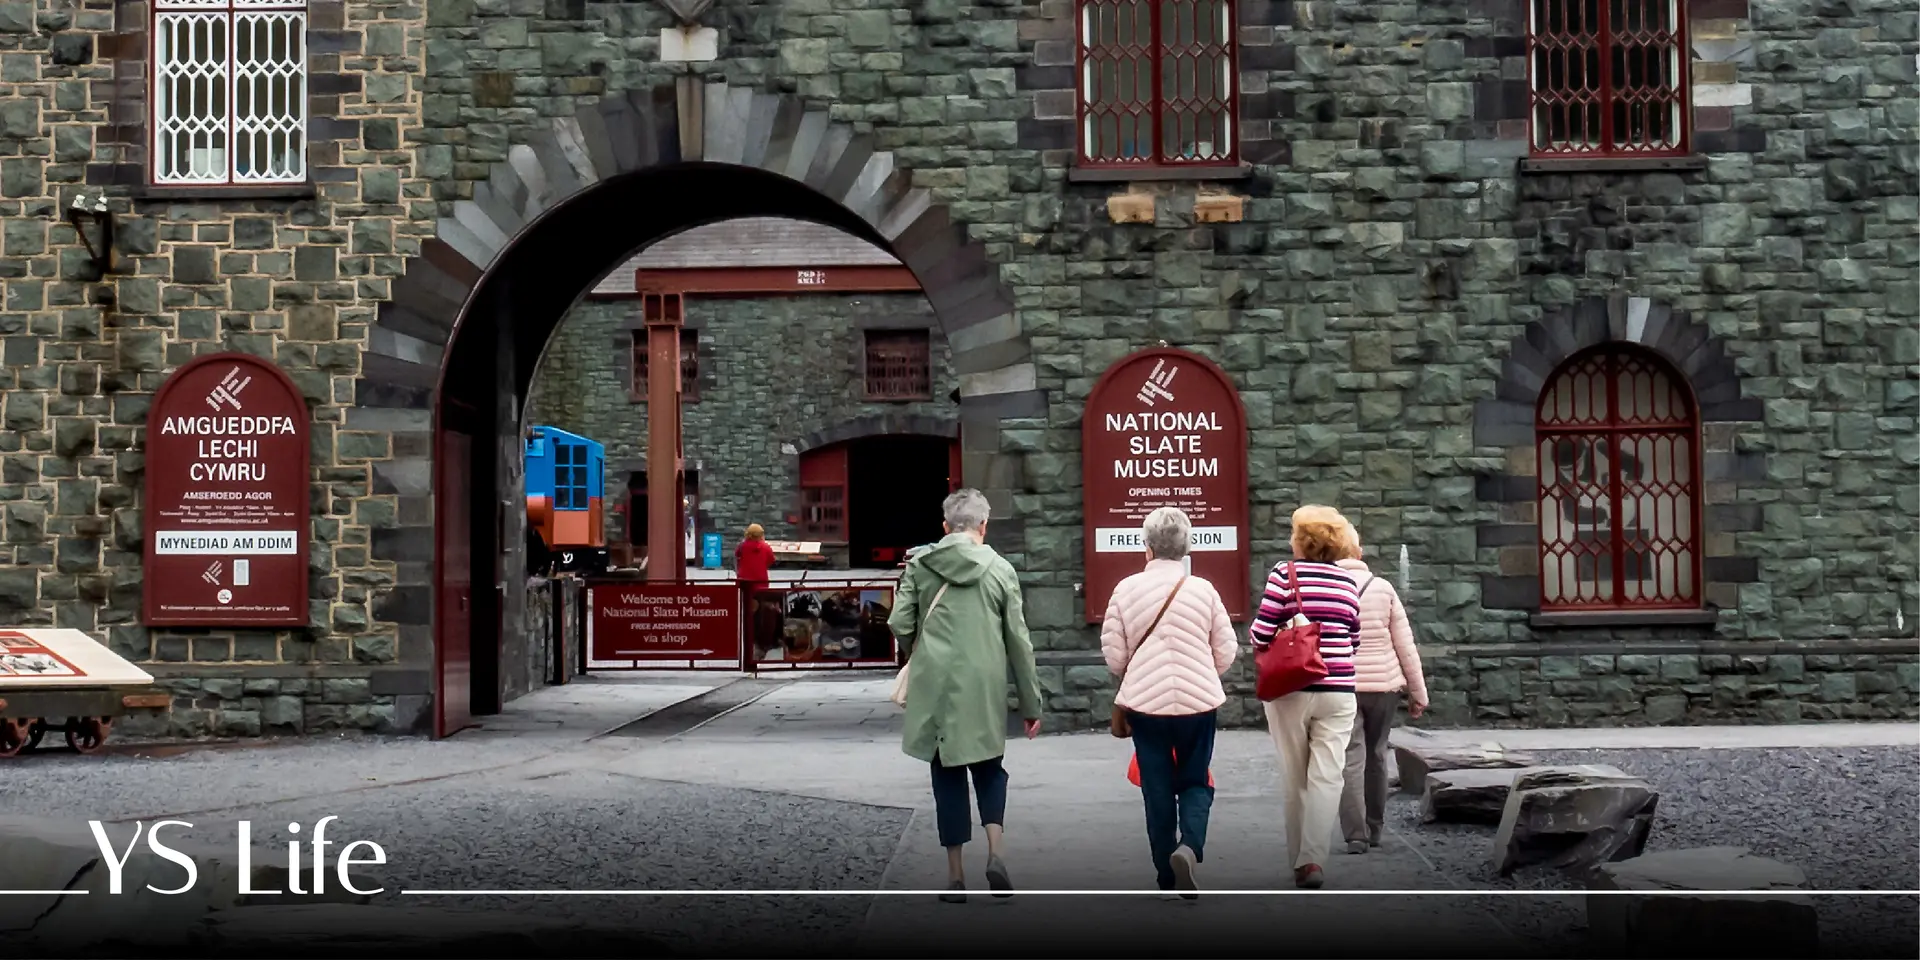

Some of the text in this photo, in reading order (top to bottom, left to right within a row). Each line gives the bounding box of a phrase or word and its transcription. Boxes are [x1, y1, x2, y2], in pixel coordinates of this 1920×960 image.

[161, 416, 296, 435] AMGUEDDFA
[1106, 412, 1222, 432] NATIONAL
[199, 439, 258, 458] LECHI
[1129, 435, 1202, 454] SLATE
[189, 463, 266, 481] CYMRU
[1114, 458, 1218, 478] MUSEUM
[183, 491, 272, 500] AMSEROEDD AGOR
[1128, 487, 1202, 497] OPENING TIMES
[160, 536, 292, 549] MYNEDIAD AM DDIM
[1109, 533, 1141, 546] FREE
[621, 594, 711, 604] Welcome to the
[603, 606, 729, 617] National Slate Museum
[643, 632, 688, 646] via shop
